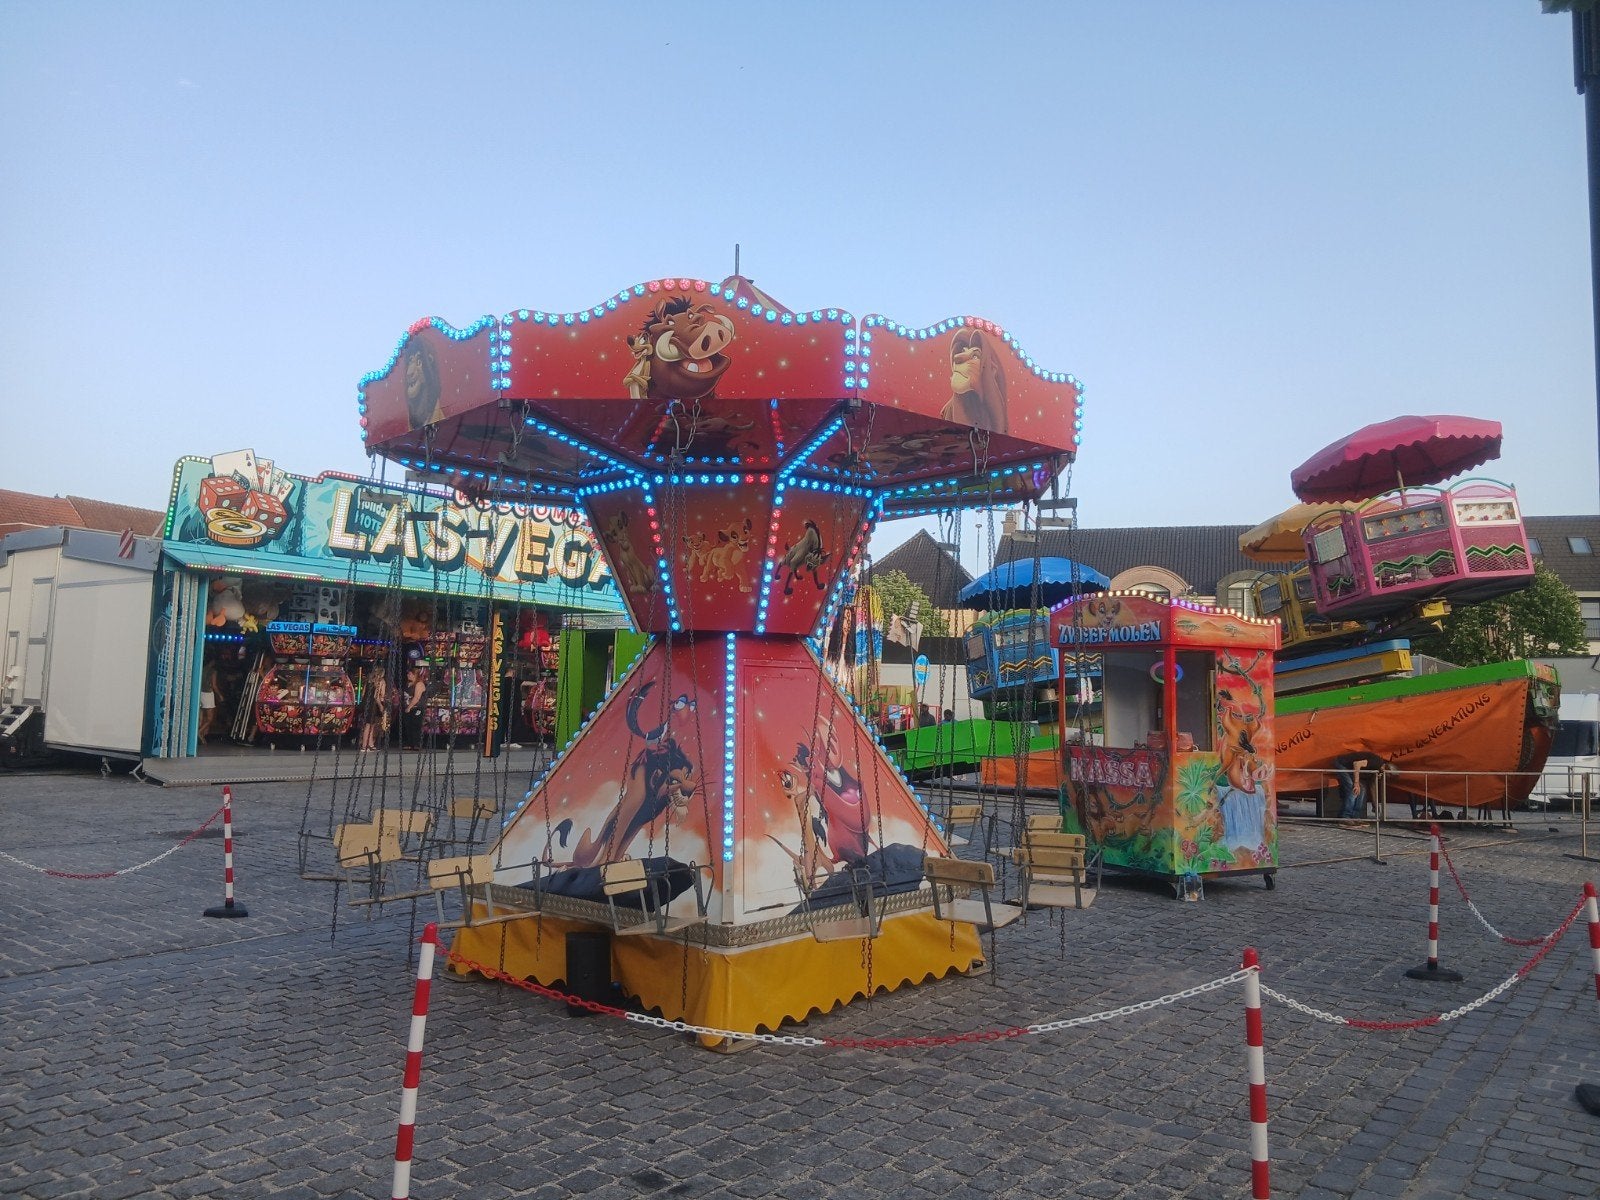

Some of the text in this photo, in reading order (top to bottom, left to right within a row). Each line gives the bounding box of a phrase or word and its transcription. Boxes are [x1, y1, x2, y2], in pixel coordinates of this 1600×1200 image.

[328, 488, 462, 562] LAS
[267, 622, 281, 631] LAS
[283, 623, 310, 632] VEGAS
[489, 612, 505, 731] LAS VEGAS
[1274, 728, 1313, 755] NSATIO
[1388, 745, 1414, 762] ALL
[1070, 757, 1154, 788] KASSA
